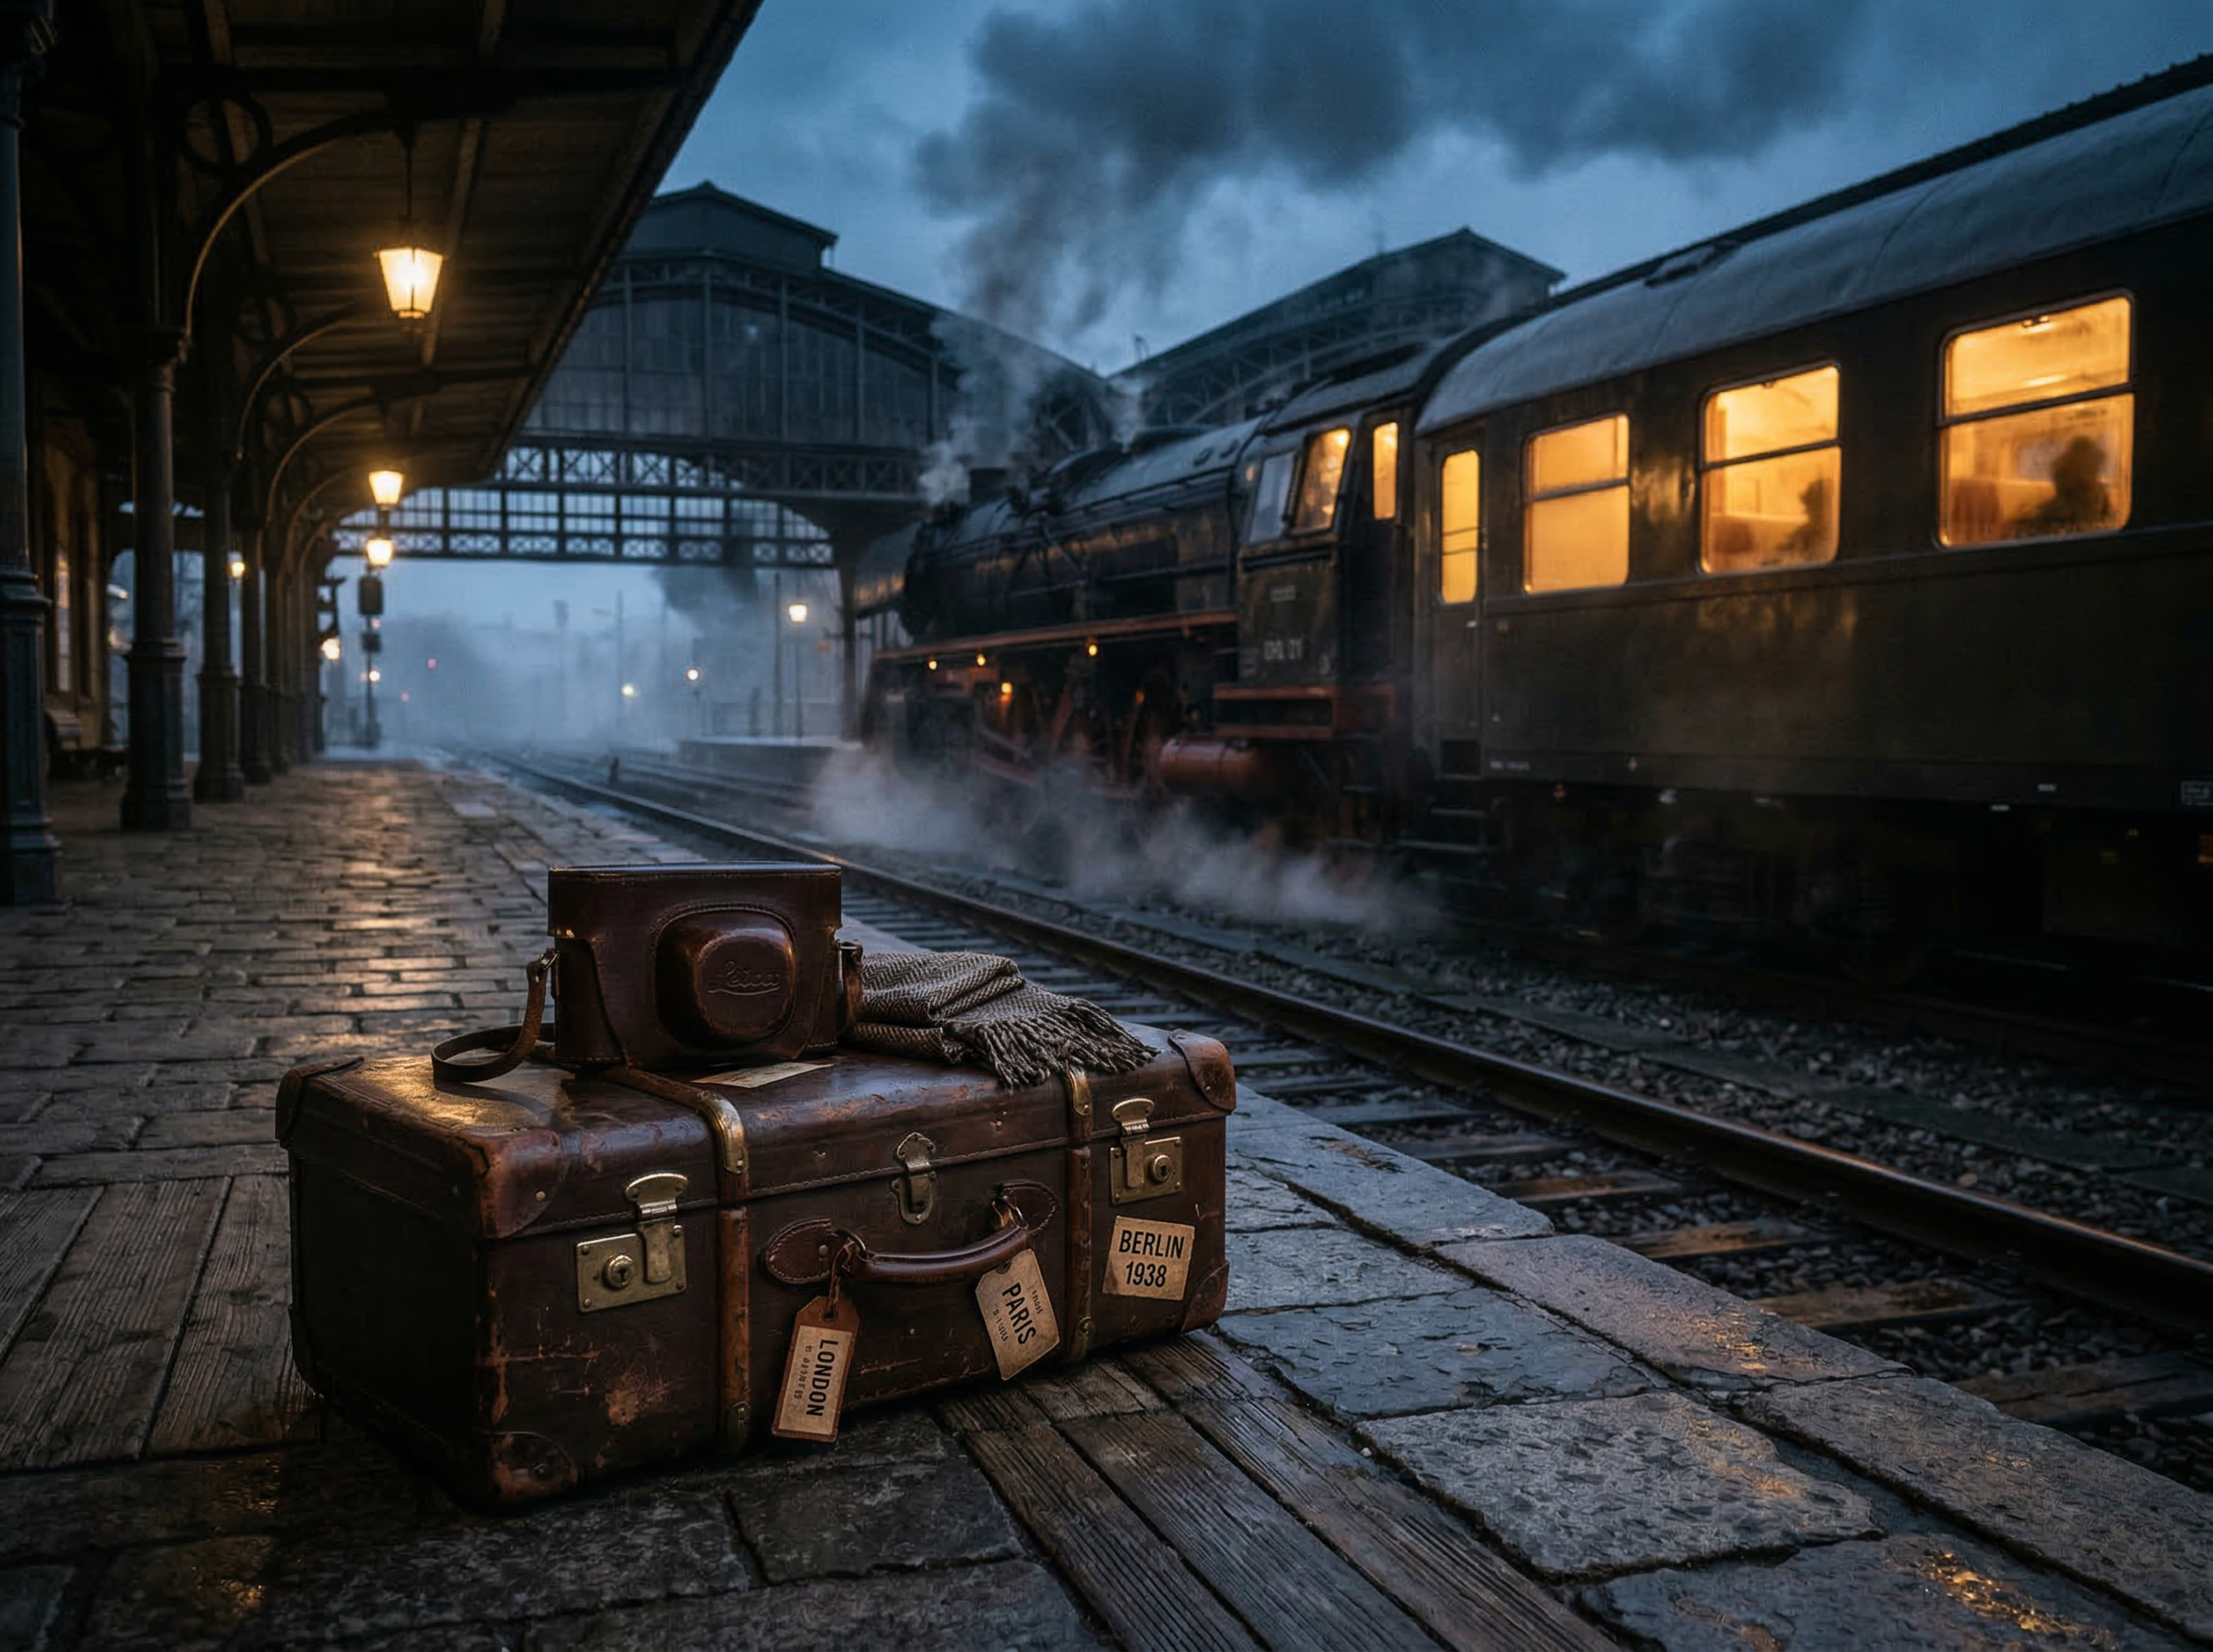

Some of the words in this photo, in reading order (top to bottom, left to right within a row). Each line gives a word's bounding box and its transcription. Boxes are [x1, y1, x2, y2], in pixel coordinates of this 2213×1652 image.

[708, 961, 781, 996] Leica
[1118, 1229, 1185, 1259] BERLIN
[1125, 1260, 1167, 1288] 1938
[1001, 1281, 1037, 1345] PARIS
[806, 1339, 839, 1417] LONDON
